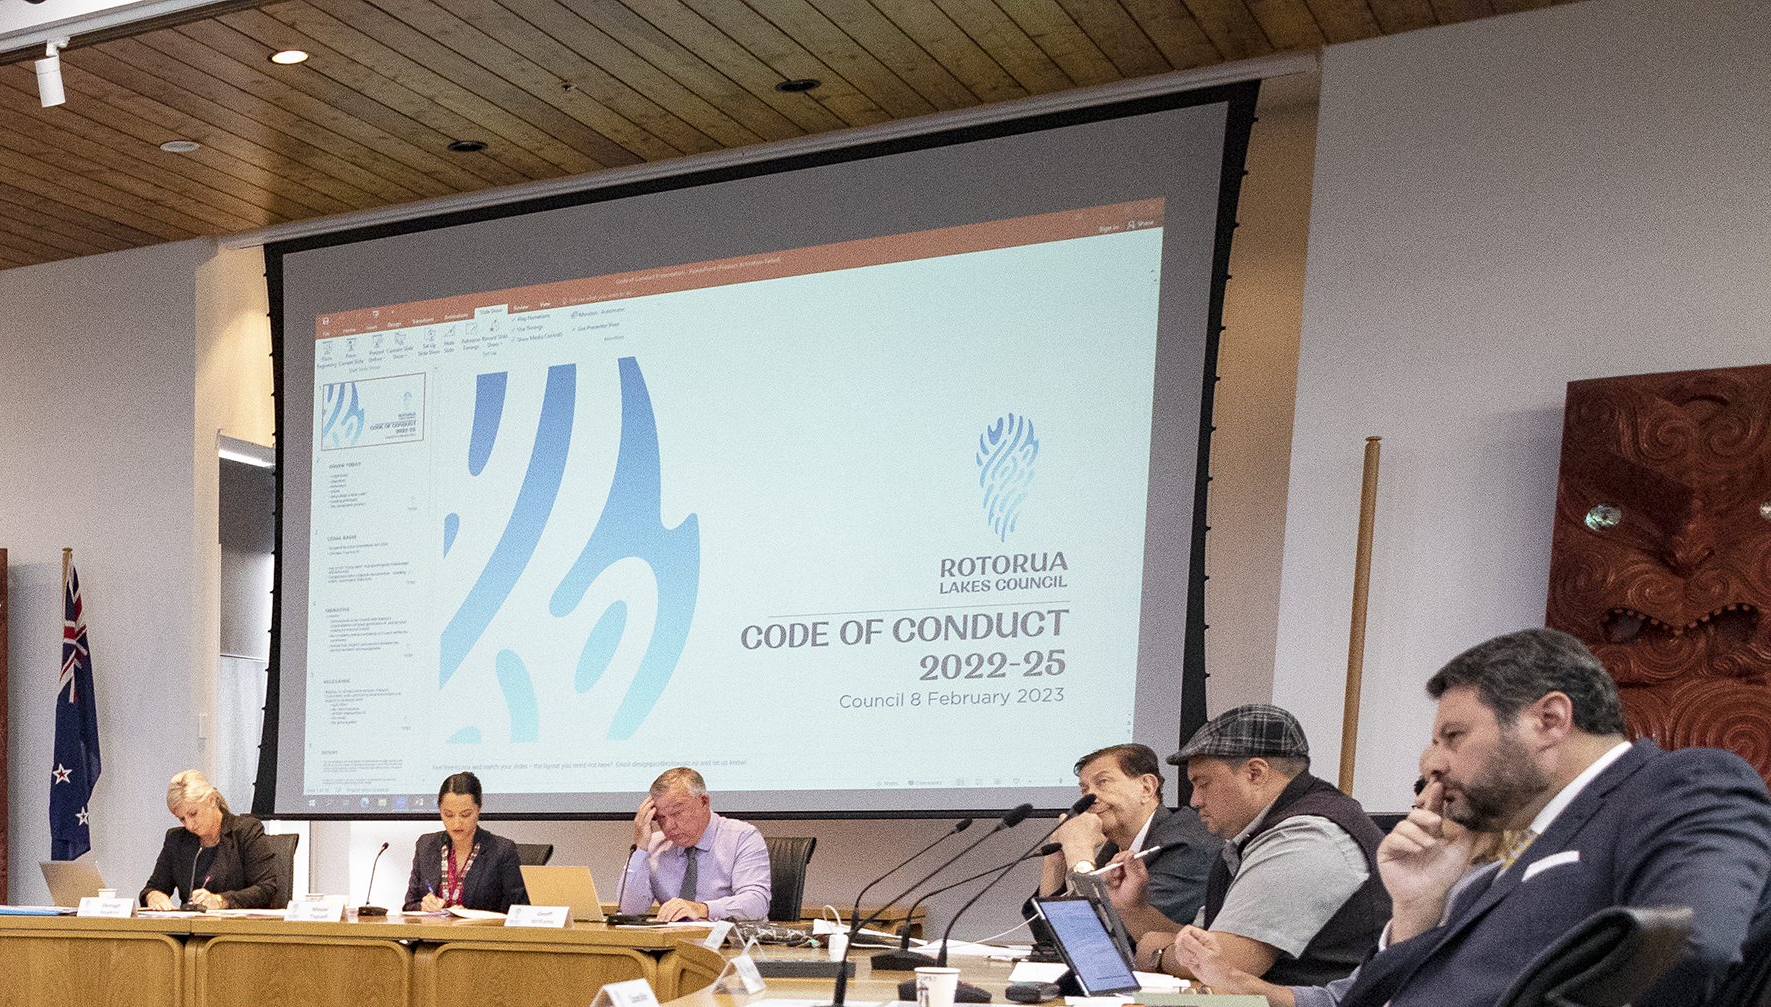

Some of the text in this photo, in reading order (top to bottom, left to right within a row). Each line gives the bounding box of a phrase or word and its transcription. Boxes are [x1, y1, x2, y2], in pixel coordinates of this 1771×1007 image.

[940, 551, 1069, 578] ROTORUA
[939, 575, 1068, 594] LAKES COUNCIL
[740, 609, 1070, 650] CODE OF CONDUCT
[918, 649, 1066, 681] 2022-25
[839, 687, 1065, 709] Council 8 February 2023
